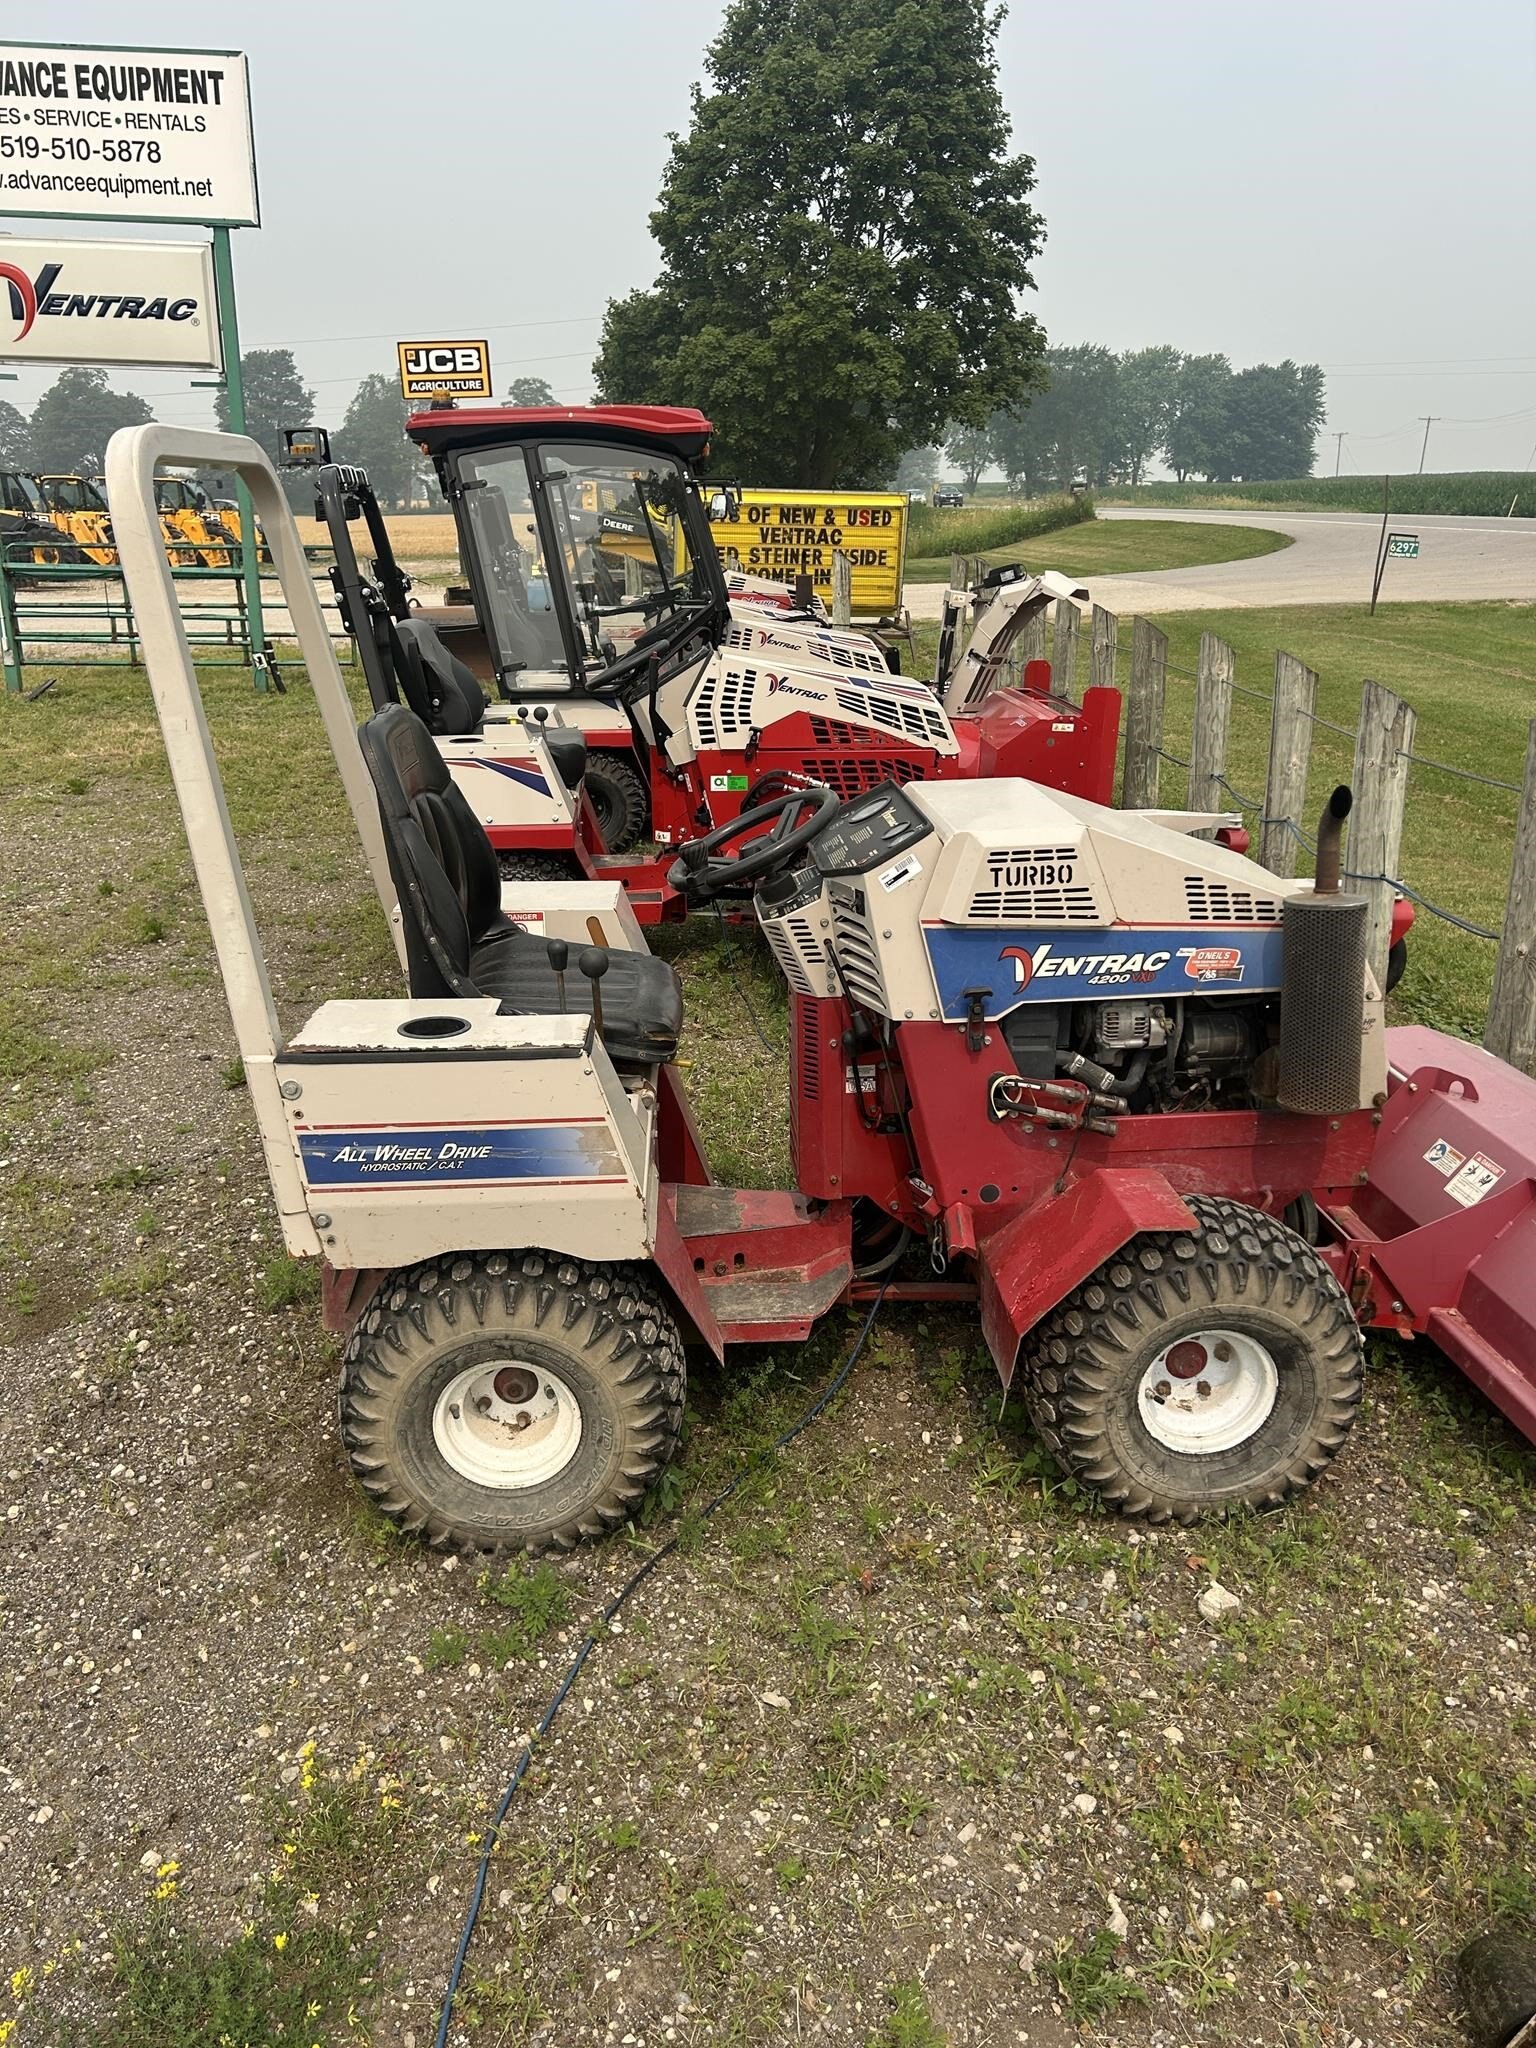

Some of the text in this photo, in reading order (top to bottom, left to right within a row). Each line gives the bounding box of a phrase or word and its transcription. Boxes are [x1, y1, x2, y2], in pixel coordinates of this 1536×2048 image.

[0, 61, 224, 105] ANCE EQUIPMENT
[34, 109, 112, 128] SERVICE
[125, 113, 206, 132] RENTALS
[1, 136, 162, 163] 519-510-5878
[7, 264, 198, 322] VENTRAC
[408, 349, 480, 373] JCB
[411, 381, 482, 391] AGRICULTURE
[603, 518, 634, 532] DEERE
[748, 506, 771, 523] OF
[780, 507, 816, 524] NEW
[824, 508, 836, 525] &
[848, 508, 892, 526] USED
[760, 527, 843, 545] VENTRAC
[749, 547, 822, 566] STEINER
[832, 549, 887, 566] SIDE
[1390, 542, 1415, 553] 6297
[760, 633, 801, 651] VENTRAC
[768, 676, 828, 701] VENTRAC
[990, 864, 1072, 888] TURBO
[1003, 944, 1171, 984] VENTRAC
[1088, 973, 1131, 985] 4200
[332, 1142, 493, 1163] ALL WHEEL DRIVE
[359, 1162, 428, 1172] HYDROSTATIC
